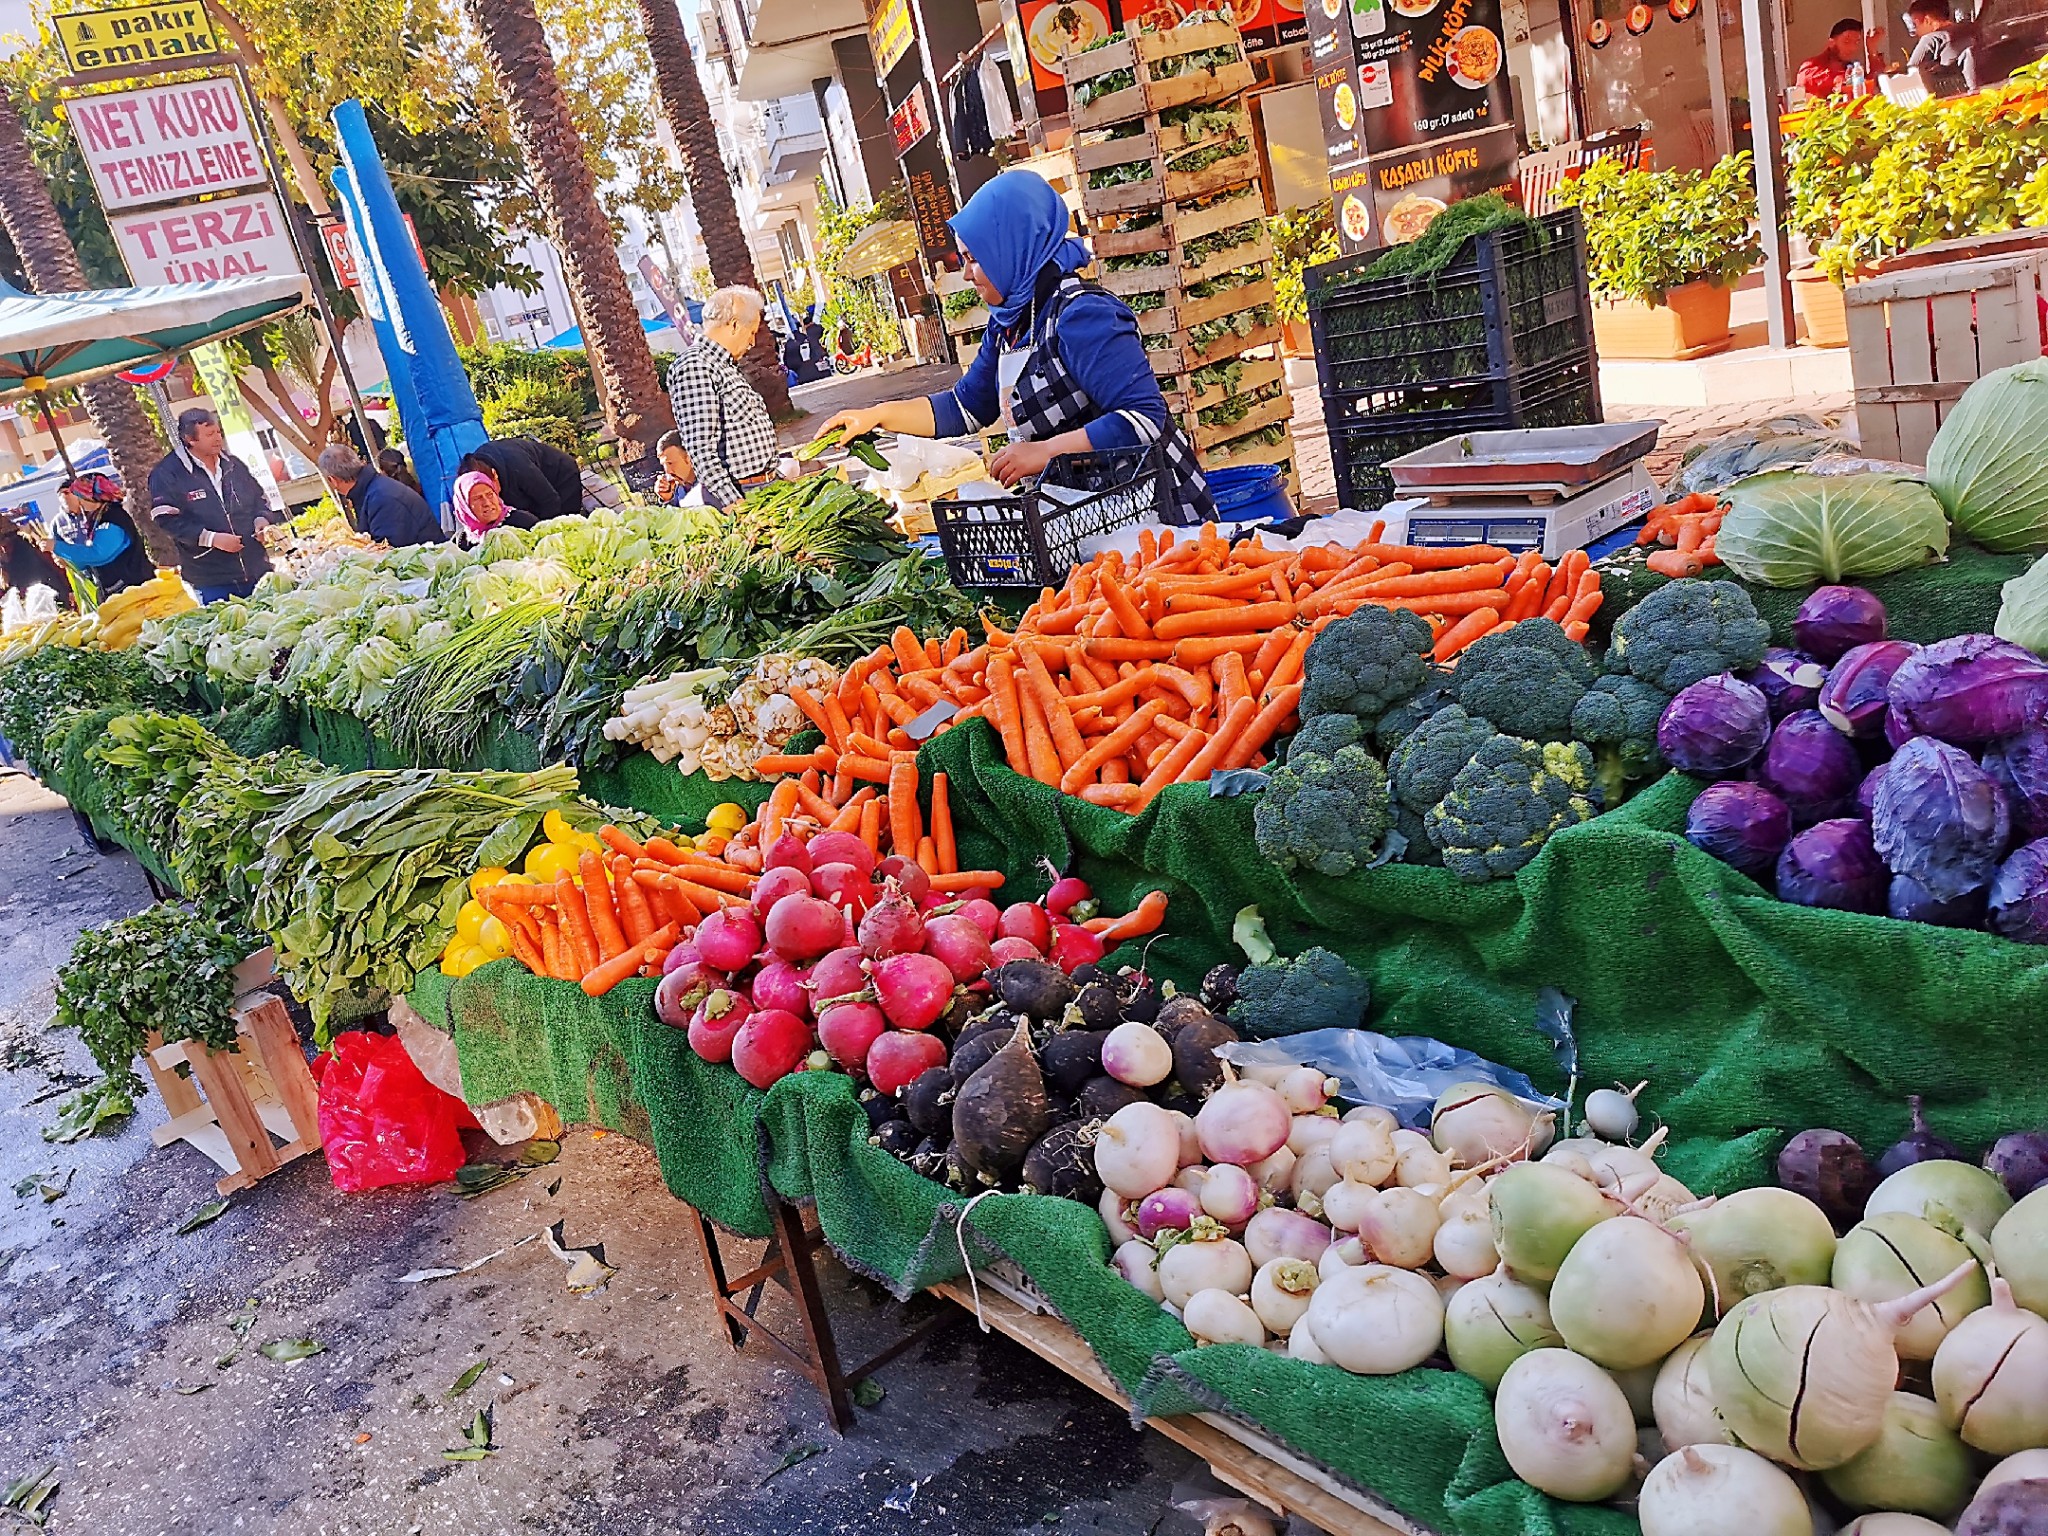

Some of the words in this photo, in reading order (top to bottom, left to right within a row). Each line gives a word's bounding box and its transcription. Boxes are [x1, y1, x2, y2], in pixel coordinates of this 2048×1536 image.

[110, 8, 196, 39] pakır
[1441, 0, 1473, 38] KÖFT
[75, 31, 212, 68] emlak
[76, 98, 146, 153] NET
[146, 85, 239, 141] KURU
[1413, 119, 1429, 133] 160
[1379, 157, 1435, 191] KAŞARLI
[1436, 147, 1480, 177] KÖFTE
[934, 226, 948, 248] KAT
[164, 251, 268, 285] ÜNAL
